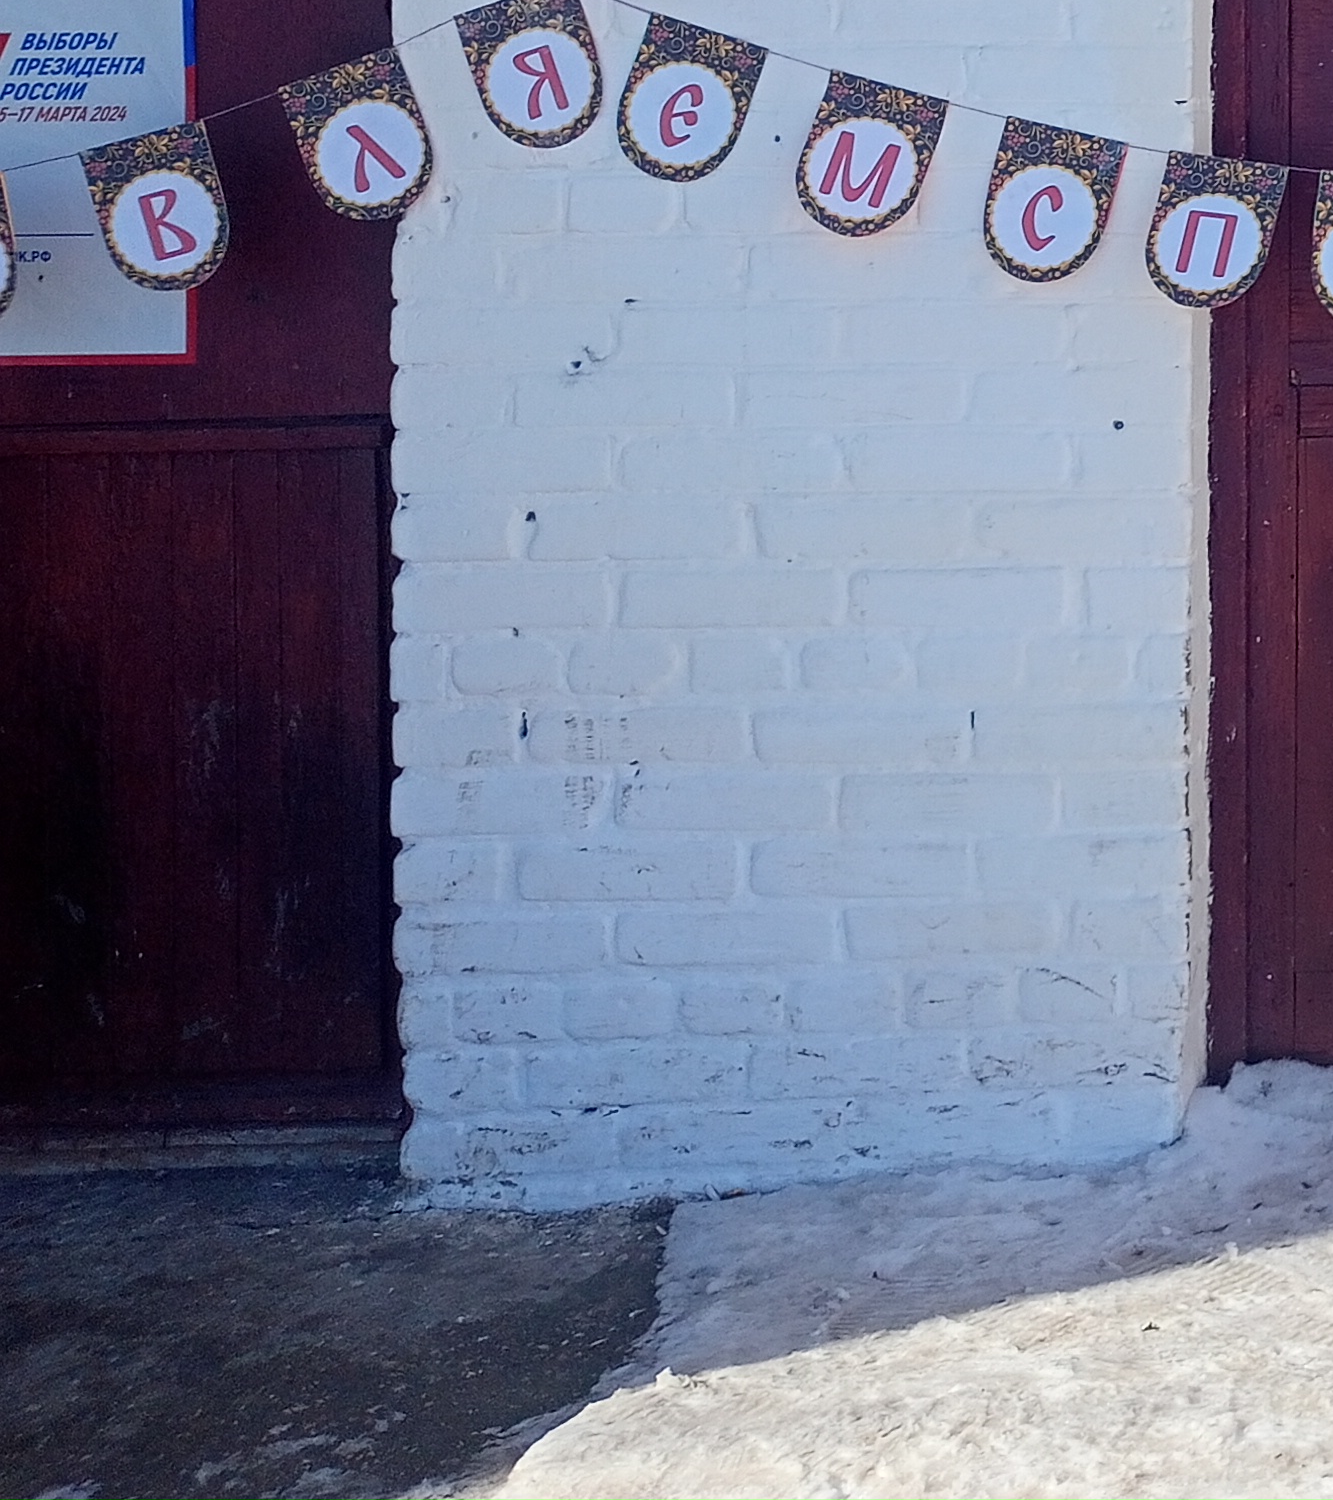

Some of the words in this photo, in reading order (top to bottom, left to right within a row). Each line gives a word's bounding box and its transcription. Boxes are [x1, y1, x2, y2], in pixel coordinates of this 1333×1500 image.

[20, 32, 119, 51] ВЫБОРЫ
[9, 57, 146, 78] ПРЕЗИДЕНТА
[0, 82, 89, 100] РОССИИ
[34, 106, 89, 122] МАРТА
[89, 105, 127, 122] 2024
